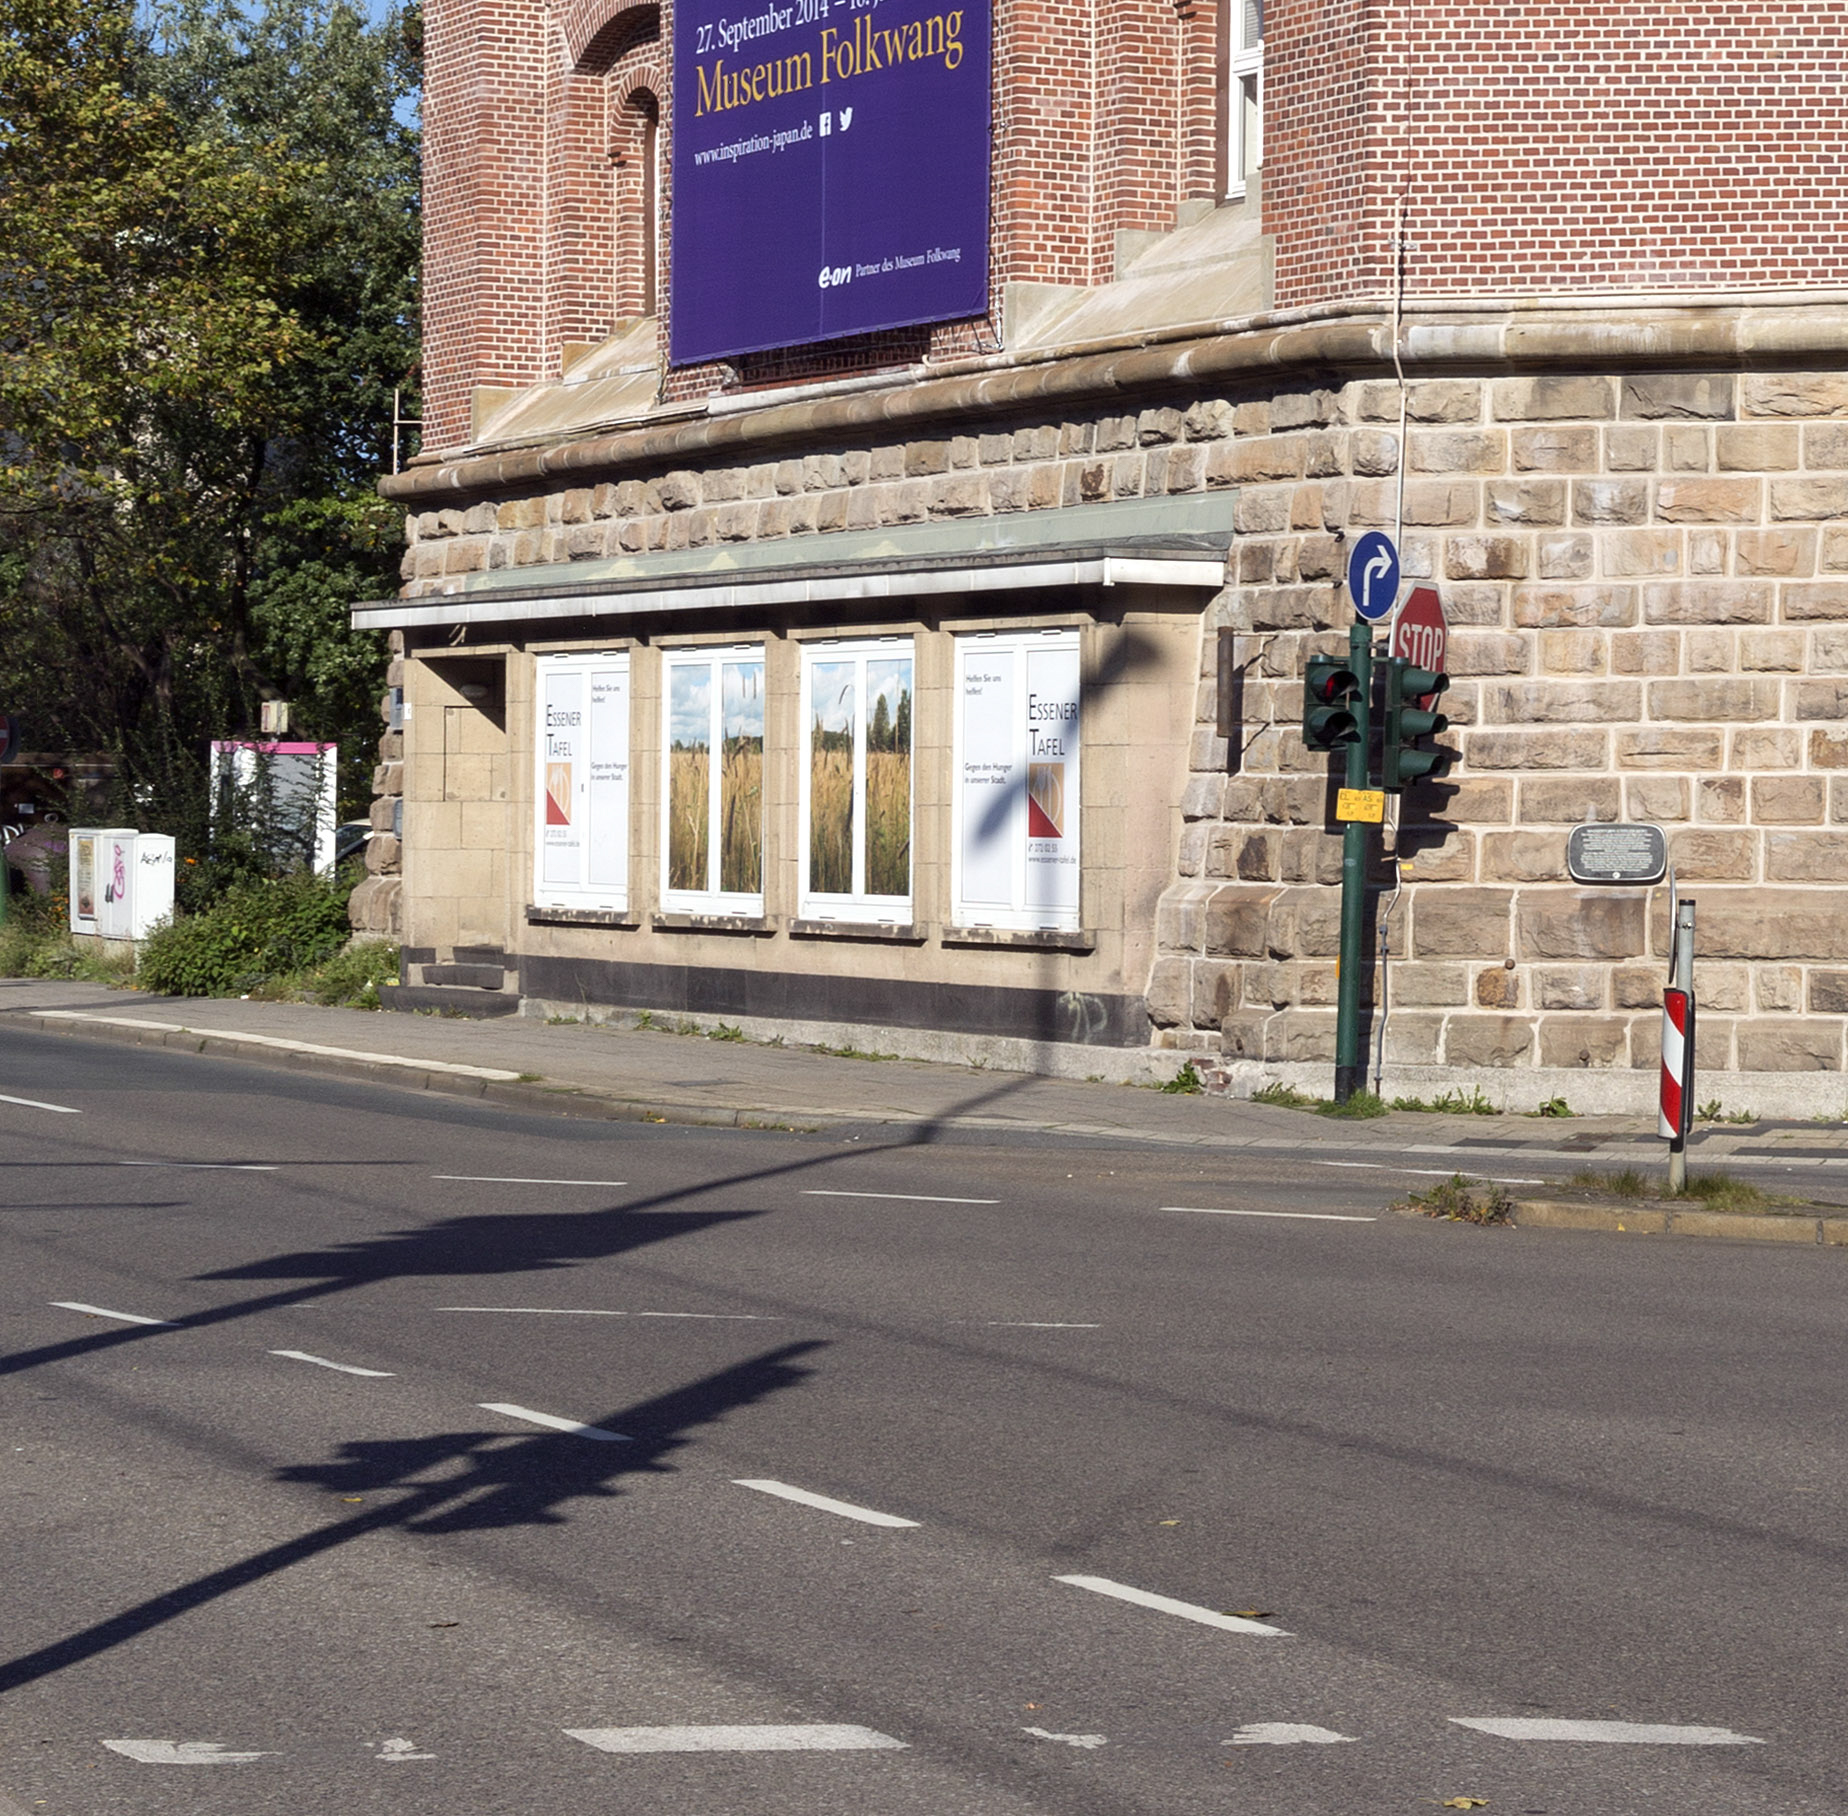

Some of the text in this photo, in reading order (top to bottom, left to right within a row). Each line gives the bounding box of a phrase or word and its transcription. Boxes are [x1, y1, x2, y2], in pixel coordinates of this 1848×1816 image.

[695, 23, 715, 55] 27.
[718, 2, 793, 52] September
[694, 10, 964, 117] Museum Folkwang
[694, 120, 813, 167] www.inspiration-japan.de
[855, 263, 881, 277] Partner
[881, 257, 894, 272] des
[894, 254, 925, 271] Museum
[926, 247, 961, 263] Folkwang
[1399, 622, 1444, 673] STOP
[546, 703, 582, 727] ESSENER
[1029, 694, 1078, 720] ESSENER
[546, 733, 573, 757] TAFEL
[1029, 728, 1065, 756] TAFEL
